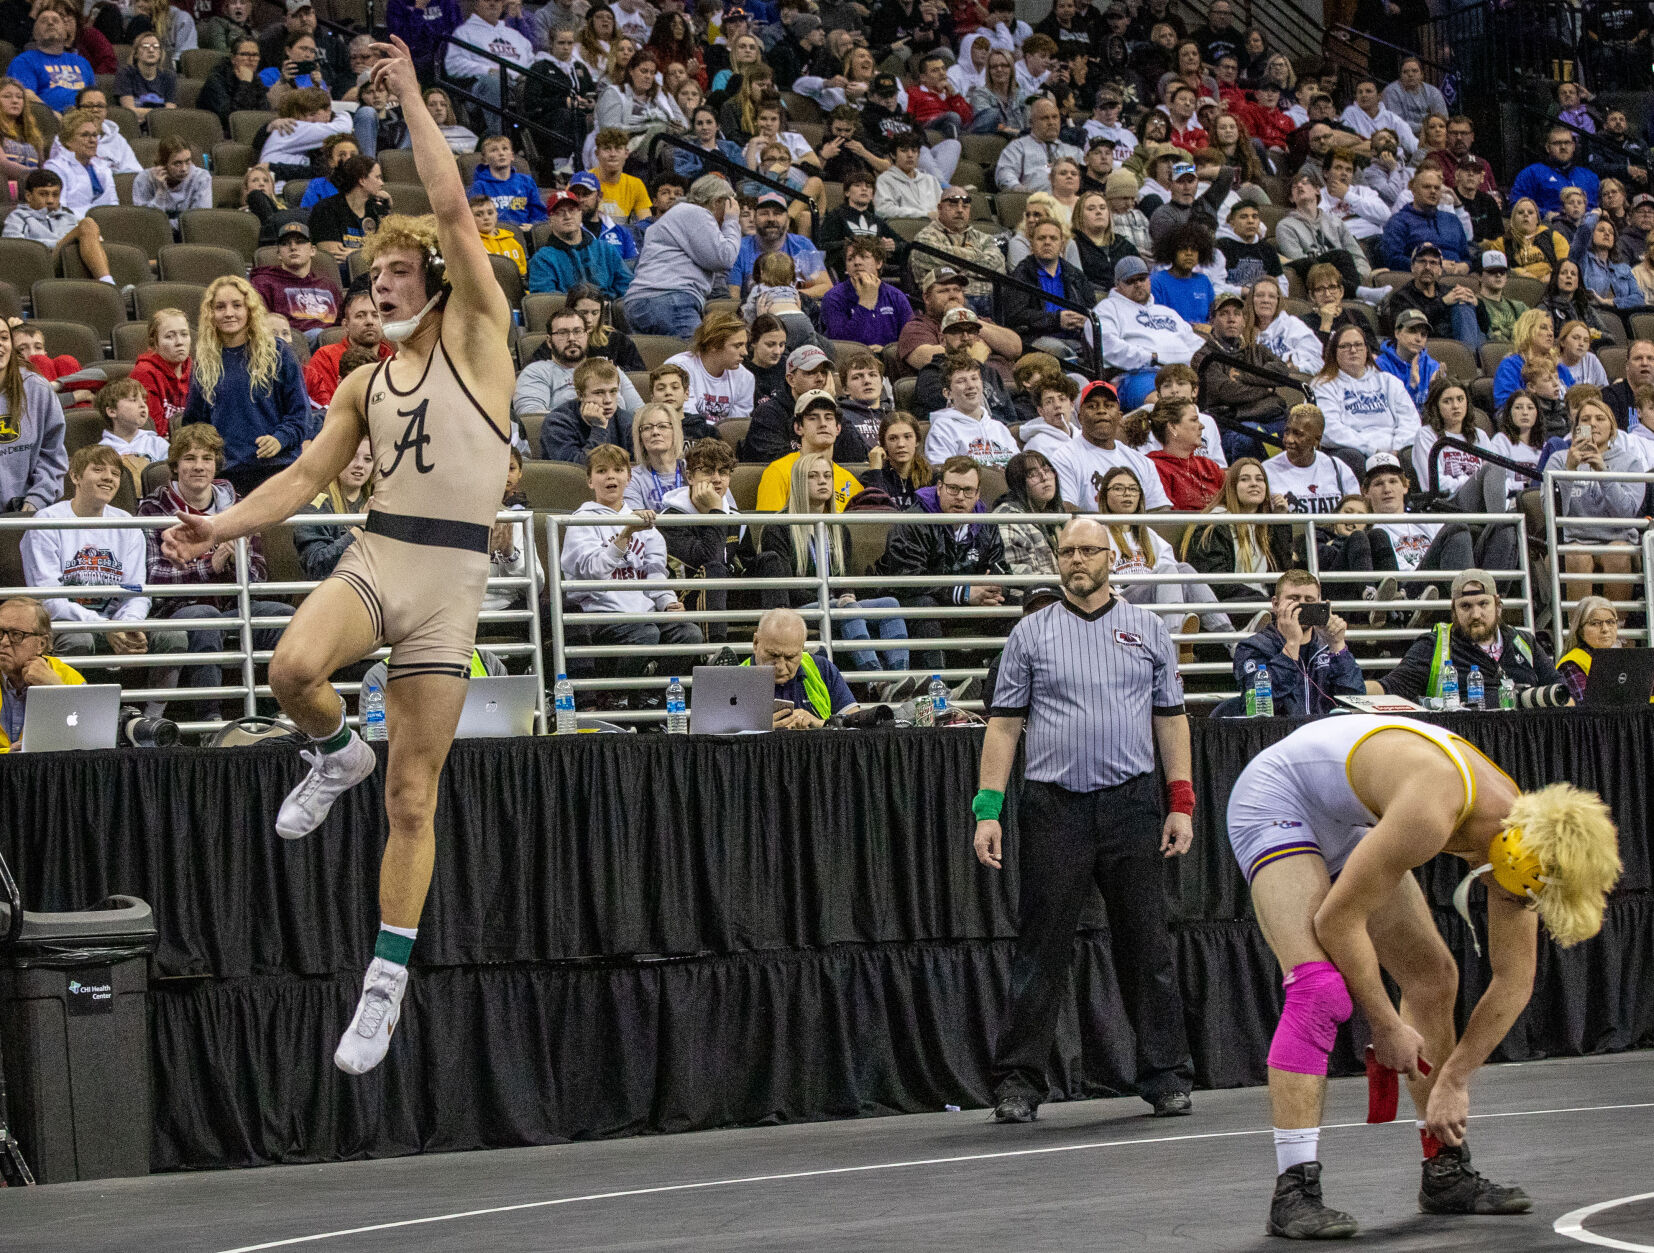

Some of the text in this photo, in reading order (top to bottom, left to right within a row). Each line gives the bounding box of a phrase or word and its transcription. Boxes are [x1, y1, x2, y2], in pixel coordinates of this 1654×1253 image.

[957, 310, 969, 321] N
[380, 398, 435, 478] A
[91, 984, 111, 993] Health
